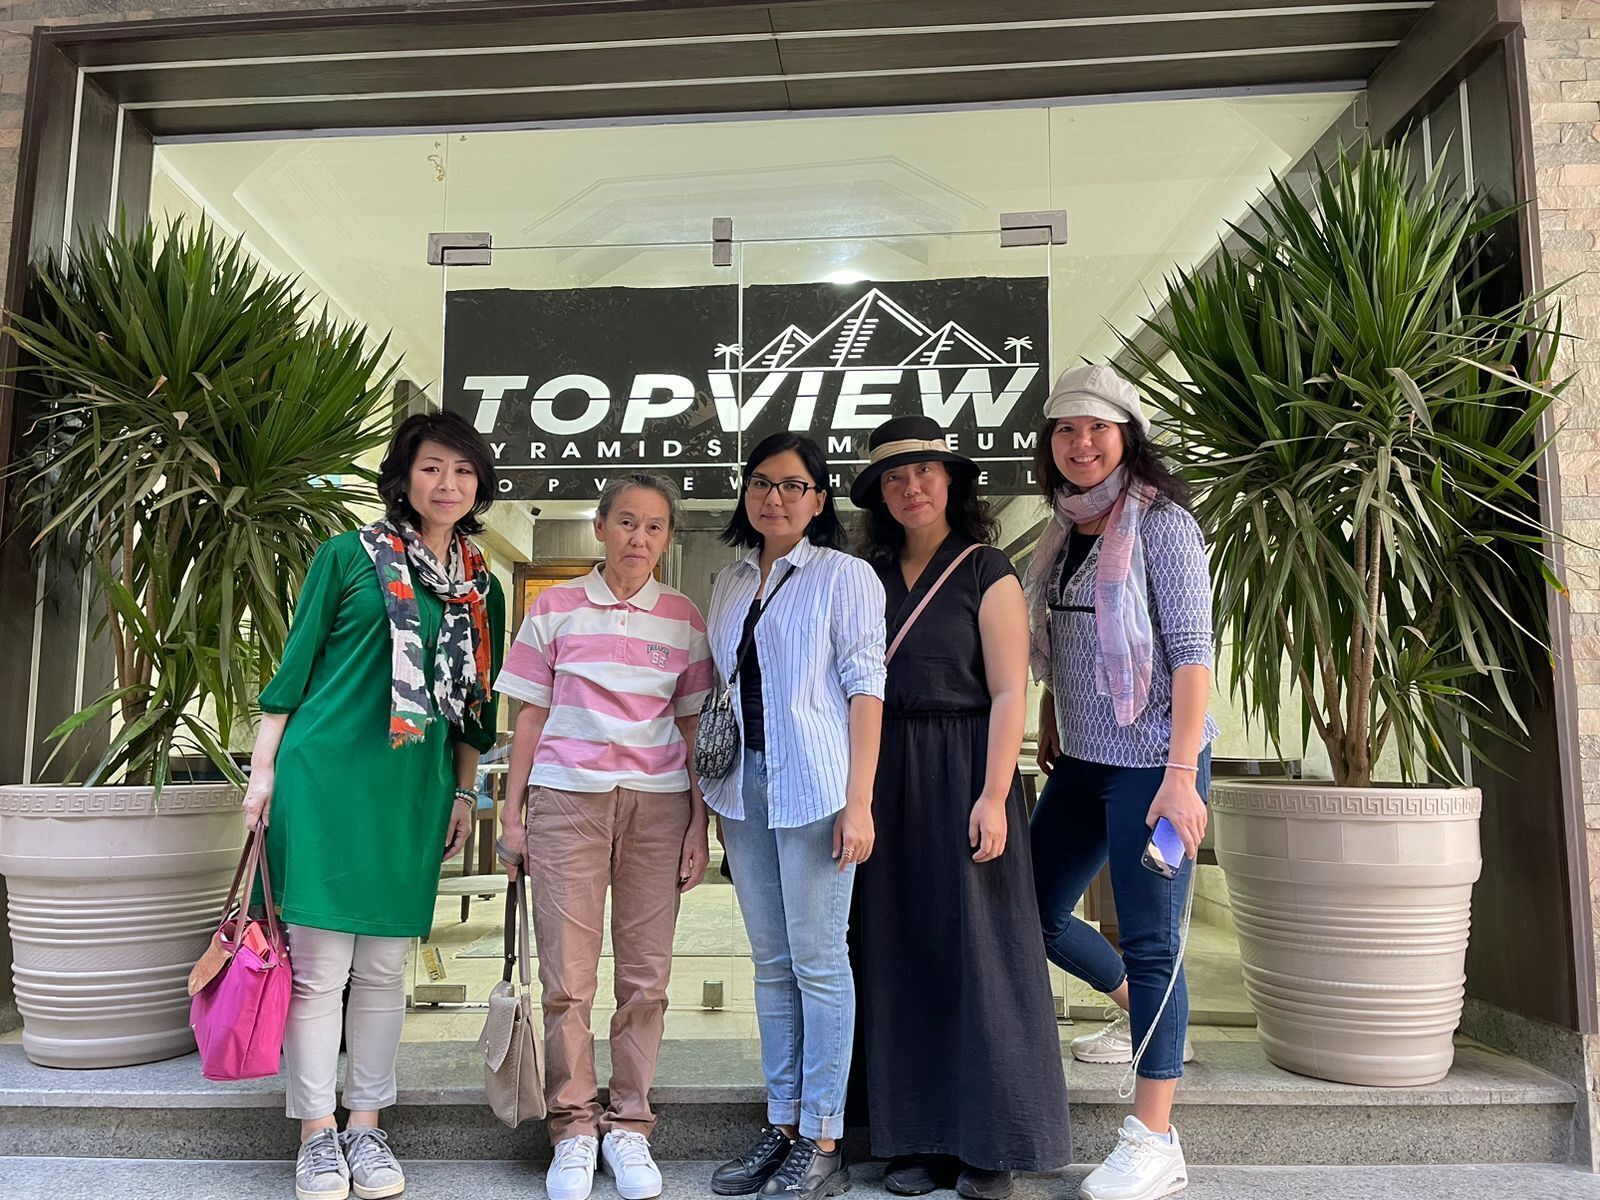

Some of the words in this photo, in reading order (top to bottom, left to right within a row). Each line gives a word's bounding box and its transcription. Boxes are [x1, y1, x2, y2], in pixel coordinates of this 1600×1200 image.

[463, 368, 1039, 435] TOPVIEW
[490, 438, 722, 459] YRAMIDS
[827, 432, 1037, 453] MEUM
[498, 475, 742, 492] OPVEW
[829, 470, 1036, 488] HEL
